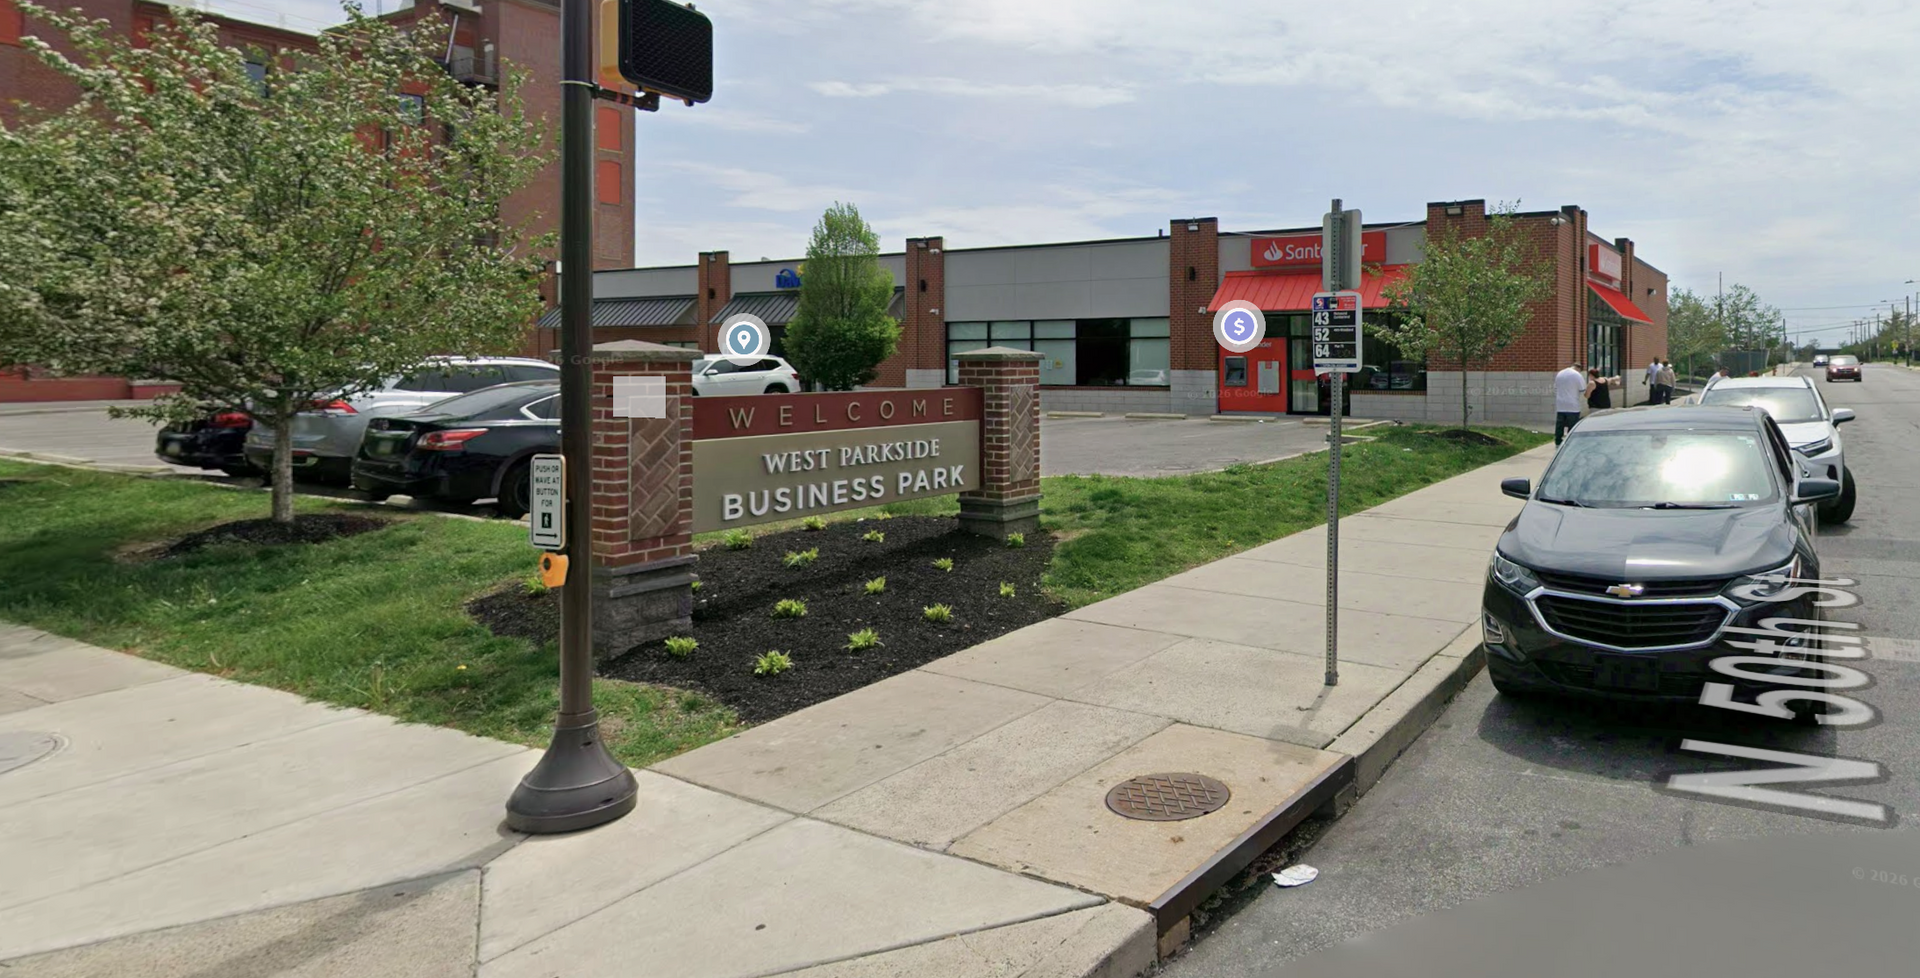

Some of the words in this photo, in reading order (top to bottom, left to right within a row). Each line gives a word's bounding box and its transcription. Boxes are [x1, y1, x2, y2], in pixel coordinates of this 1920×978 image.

[1285, 243, 1368, 260] Santr
[1315, 311, 1329, 325] 43
[1315, 328, 1330, 341] 52
[1315, 344, 1330, 357] 64
[729, 398, 954, 429] WELCOME
[763, 448, 831, 474] WEST
[839, 438, 940, 467] PARKSIDE
[536, 488, 559, 496] BUTTON
[722, 475, 885, 521] BUSINESS
[898, 464, 965, 495] PARK
[541, 499, 553, 507] FOR
